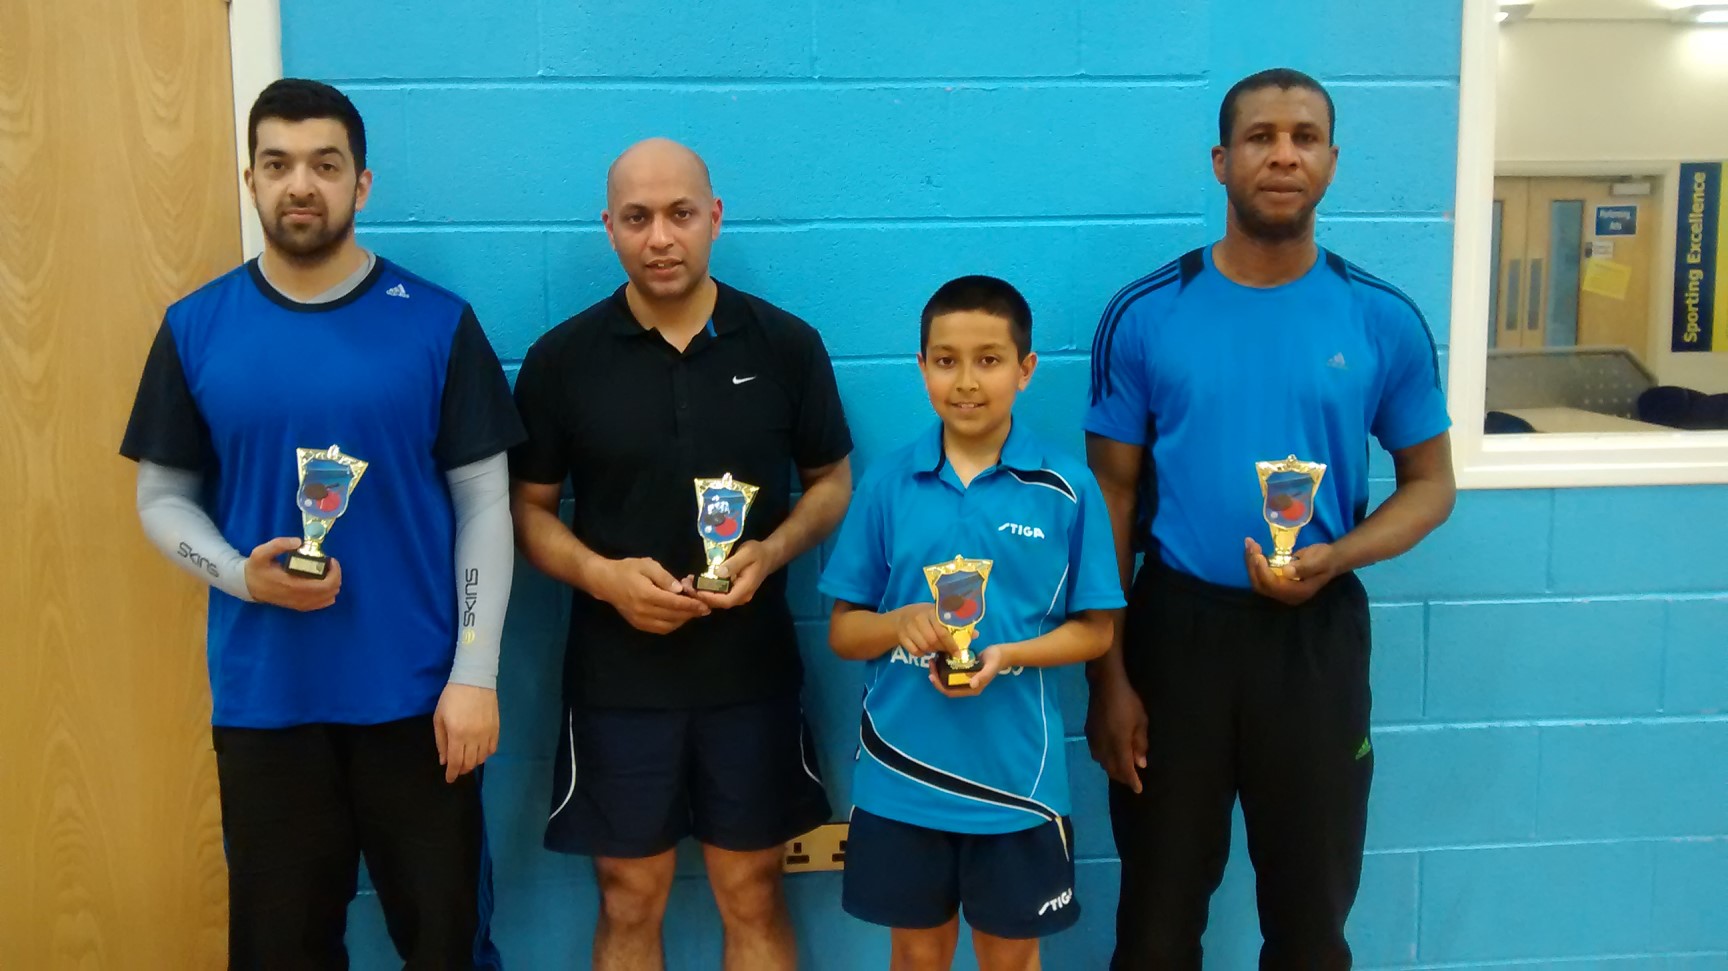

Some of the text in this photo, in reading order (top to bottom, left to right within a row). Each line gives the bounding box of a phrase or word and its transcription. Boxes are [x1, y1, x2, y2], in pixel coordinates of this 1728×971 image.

[1683, 172, 1706, 342] Sporting Excellence
[998, 522, 1045, 539] STIGA
